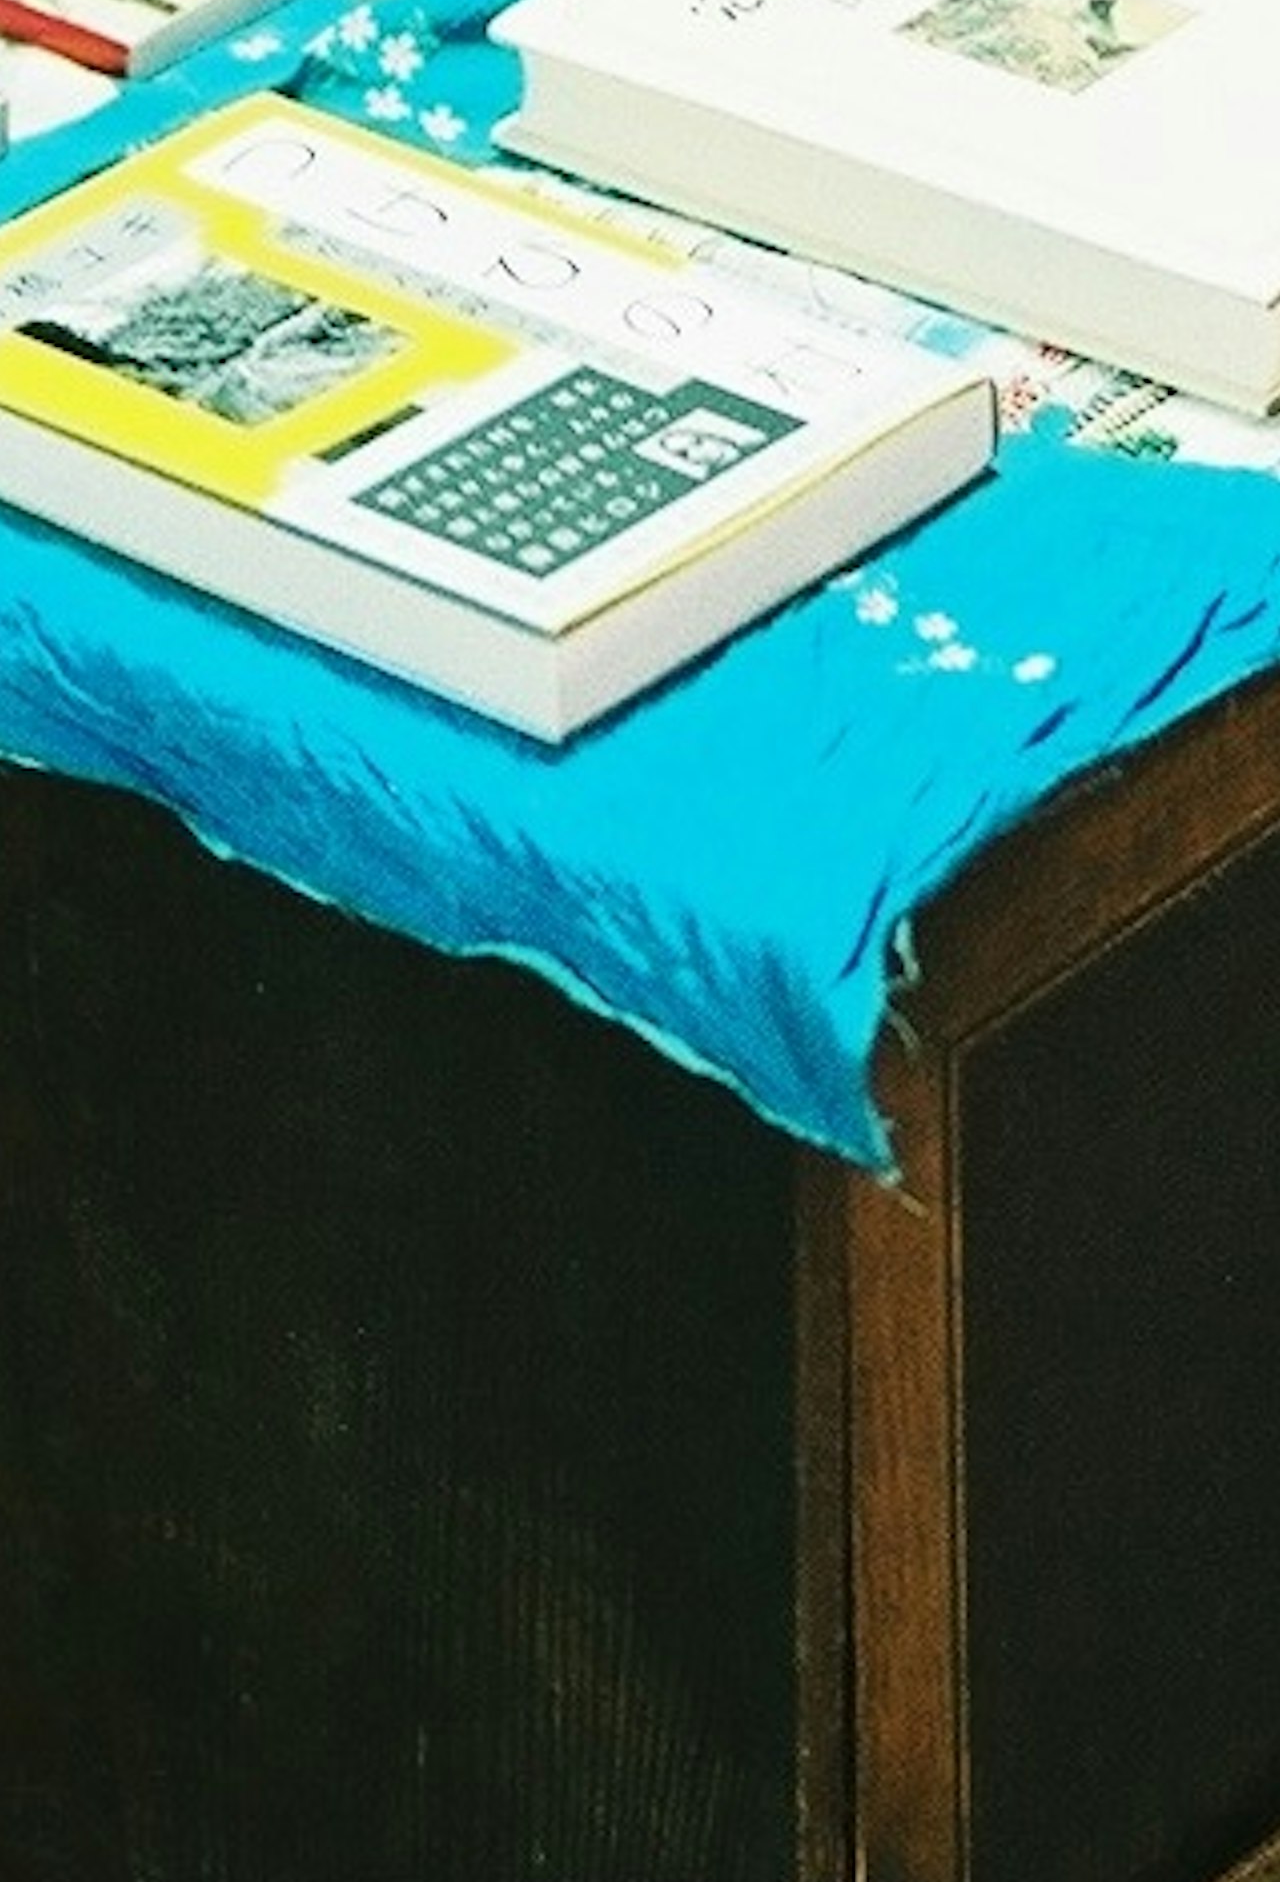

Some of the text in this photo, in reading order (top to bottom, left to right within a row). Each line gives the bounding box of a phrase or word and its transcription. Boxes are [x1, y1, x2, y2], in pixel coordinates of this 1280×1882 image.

[227, 139, 866, 397] つけびの村
